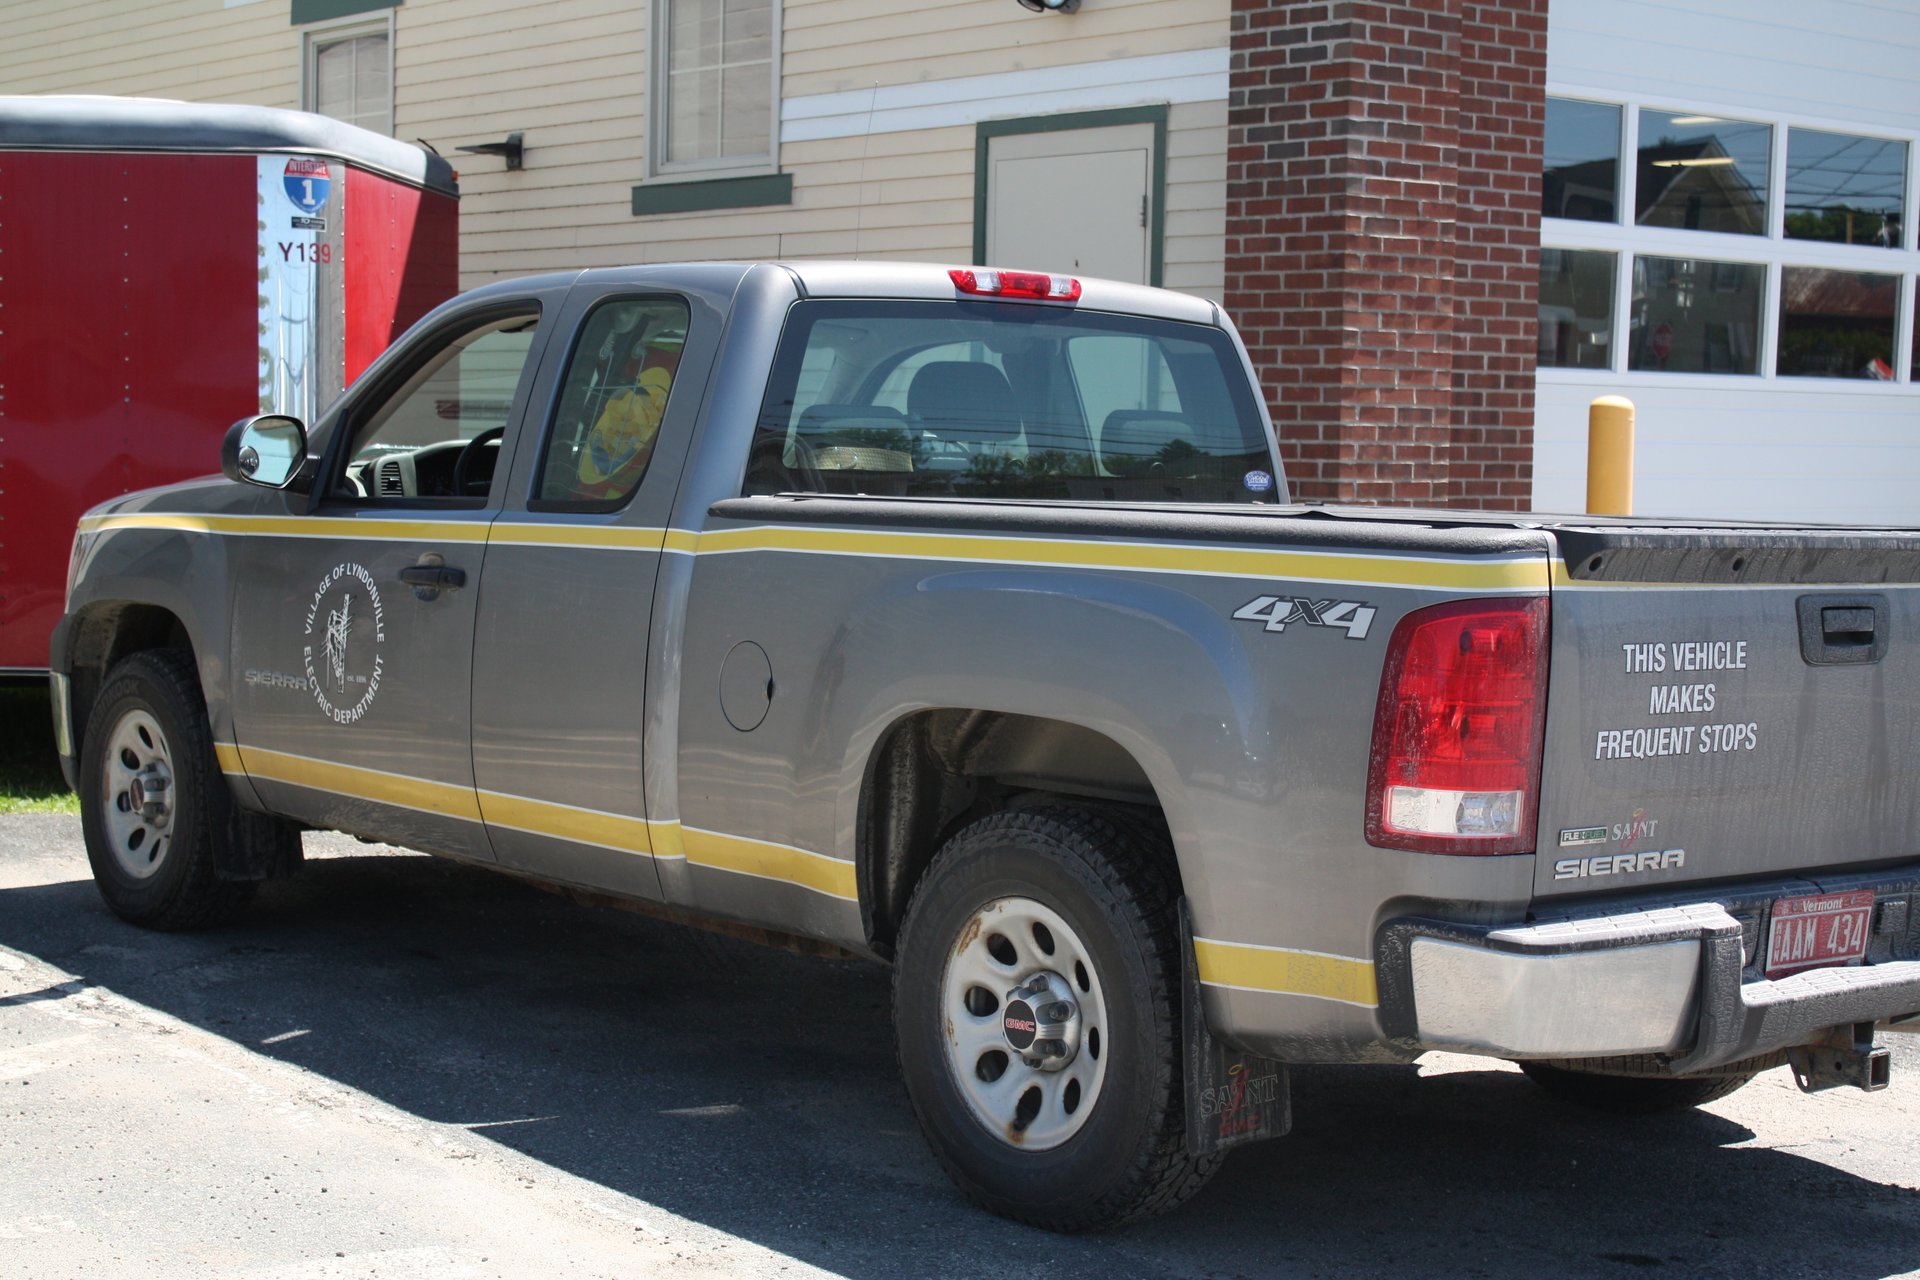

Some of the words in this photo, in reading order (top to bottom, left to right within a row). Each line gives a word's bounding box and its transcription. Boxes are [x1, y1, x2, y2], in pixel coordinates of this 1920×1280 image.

[302, 179, 316, 205] 1
[278, 242, 331, 264] Y139
[305, 574, 332, 634] VILLAGE
[332, 564, 345, 580] OF
[347, 562, 385, 643] LYNDONVILLE
[1622, 643, 1666, 673] THIS
[1671, 641, 1747, 671] VEHICLE
[244, 668, 308, 691] SIERRA
[304, 646, 332, 717] ELECTRIC
[334, 654, 384, 724] DEPARTMENT
[1649, 683, 1716, 715] MAKES
[1595, 726, 1695, 760] FREQUENT
[1699, 722, 1758, 754] STOPS
[1554, 849, 1685, 880] SIERRA
[1802, 898, 1843, 912] Vermont
[1827, 912, 1864, 954] 434
[1006, 1018, 1034, 1032] GMC
